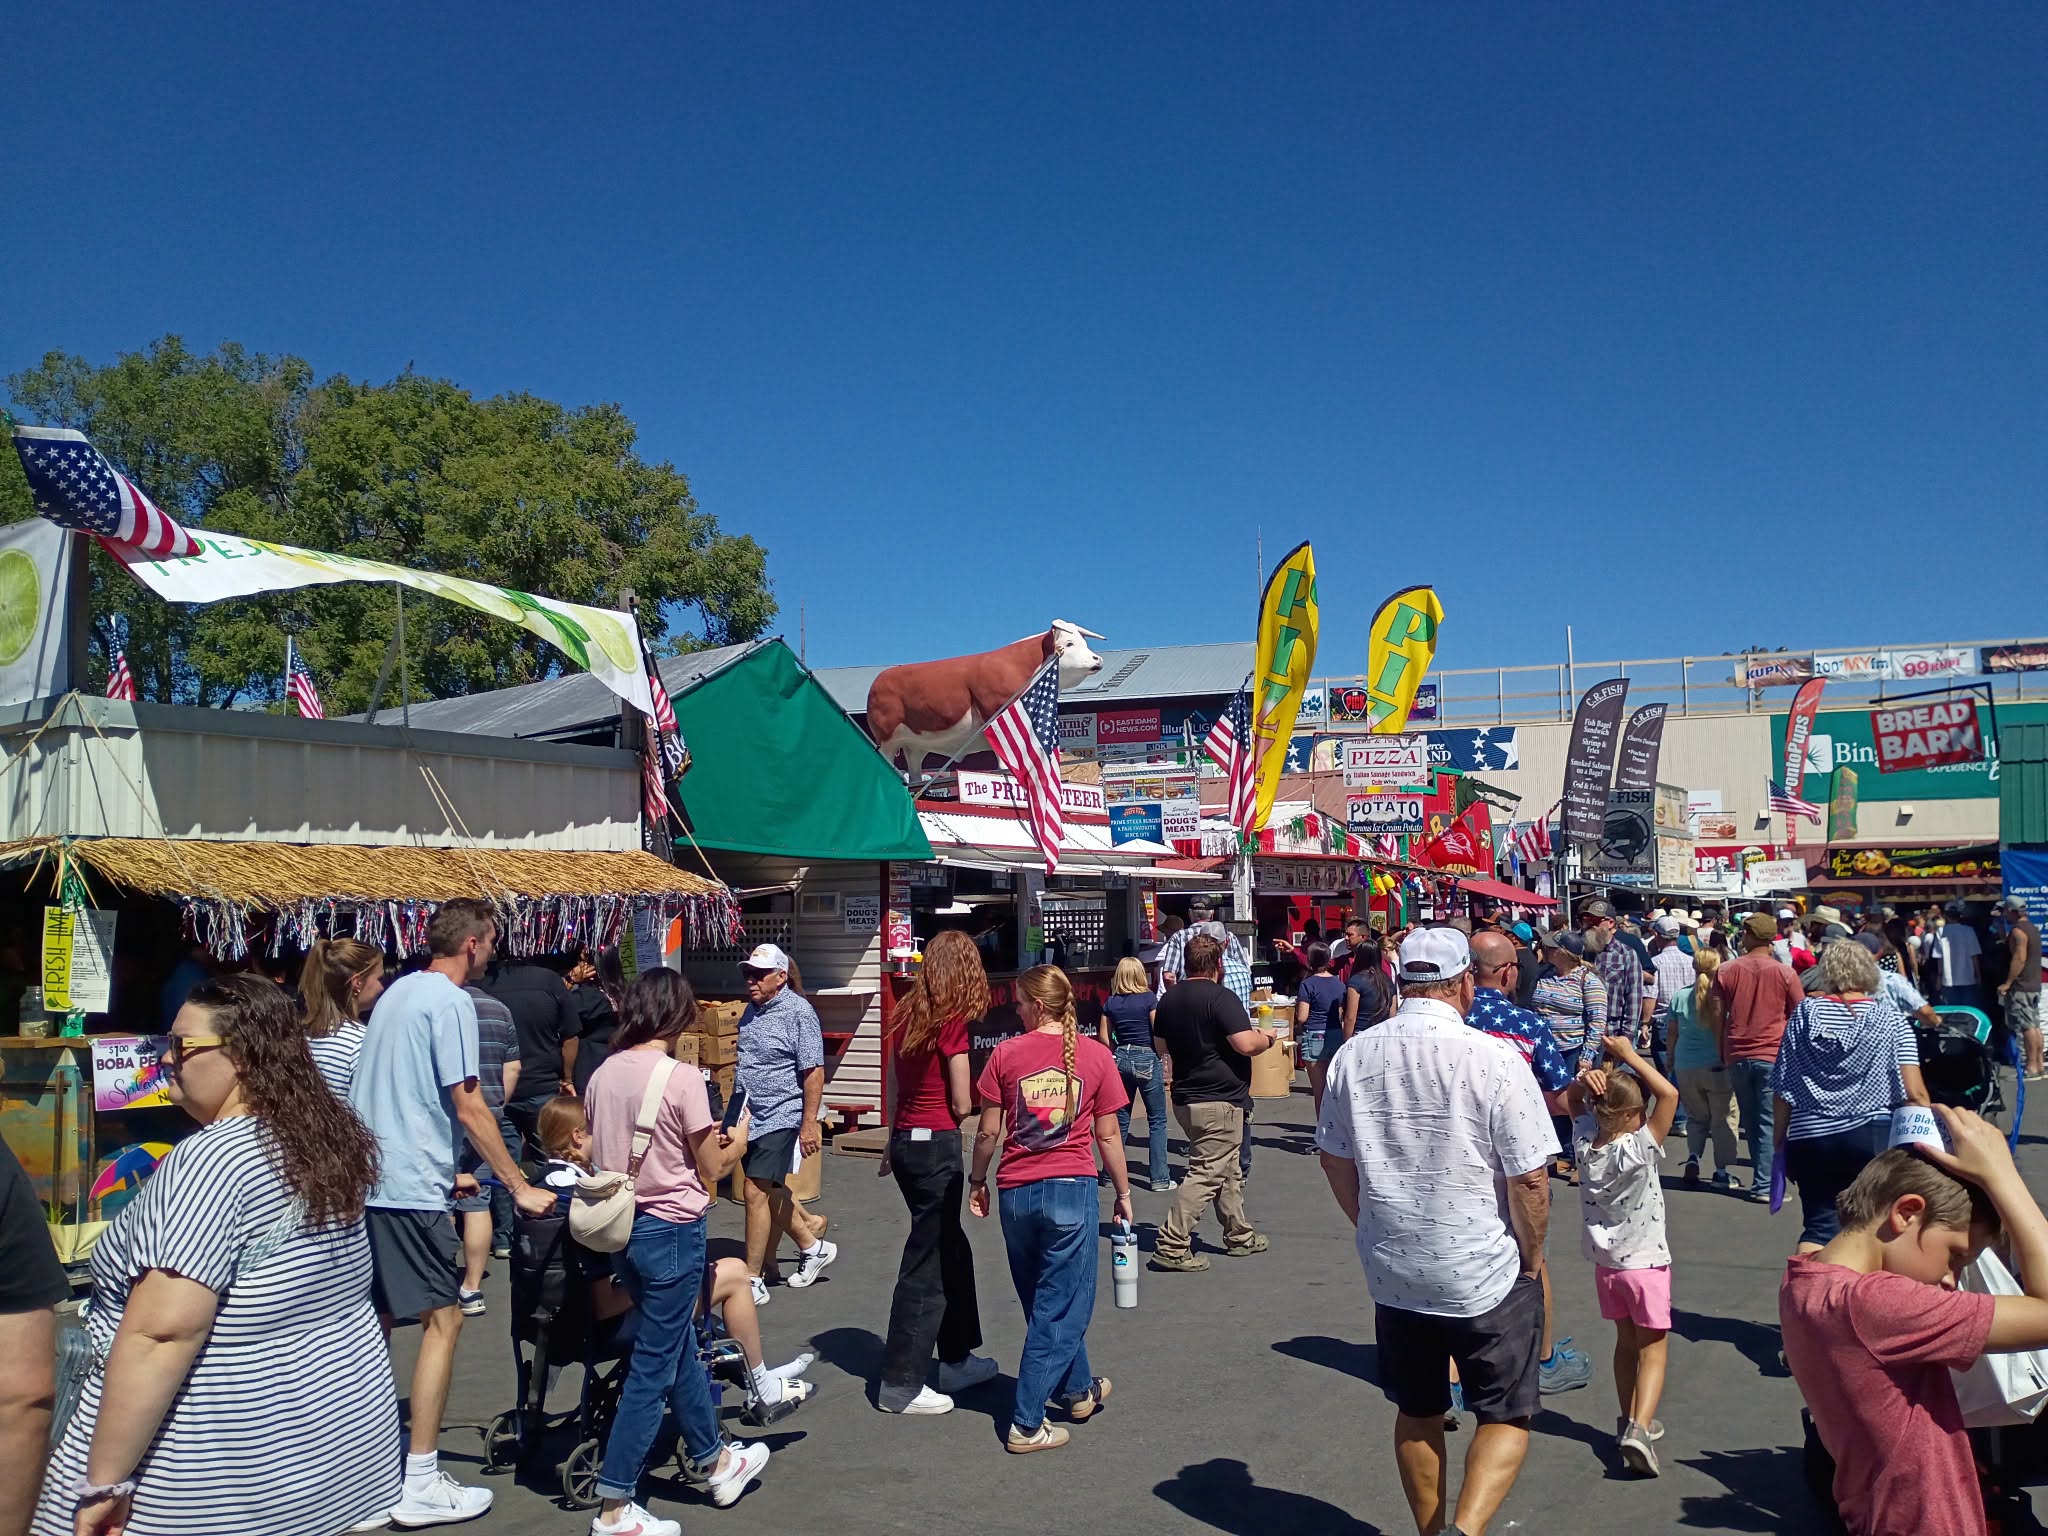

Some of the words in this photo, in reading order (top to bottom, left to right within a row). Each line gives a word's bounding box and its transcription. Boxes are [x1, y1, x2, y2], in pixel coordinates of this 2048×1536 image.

[1877, 703, 1970, 734] BREAD
[1059, 727, 1090, 737] anch
[1116, 724, 1158, 733] NEWS.COM
[1583, 726, 1609, 736] Sandwich
[1581, 738, 1601, 748] Shrimp
[1881, 725, 1977, 761] BARN
[1586, 745, 1600, 755] Fries
[1351, 750, 1420, 766] PIZZA
[1784, 714, 1810, 797] rontoPups
[1371, 771, 1392, 779] Sausage
[1391, 770, 1416, 778] Sandwich
[965, 782, 988, 796] The
[992, 781, 1029, 801] PRI
[1616, 791, 1650, 803] FISH
[1350, 800, 1420, 821] POTATO
[1163, 816, 1198, 825] DOUG'S
[1165, 825, 1196, 833] MEATS
[1348, 823, 1373, 833] Famous
[1381, 824, 1403, 833] Cream
[1402, 823, 1423, 832] Potato
[846, 909, 878, 917] DOUG'S
[44, 947, 67, 994] FRESH
[96, 1057, 135, 1071] BOBA
